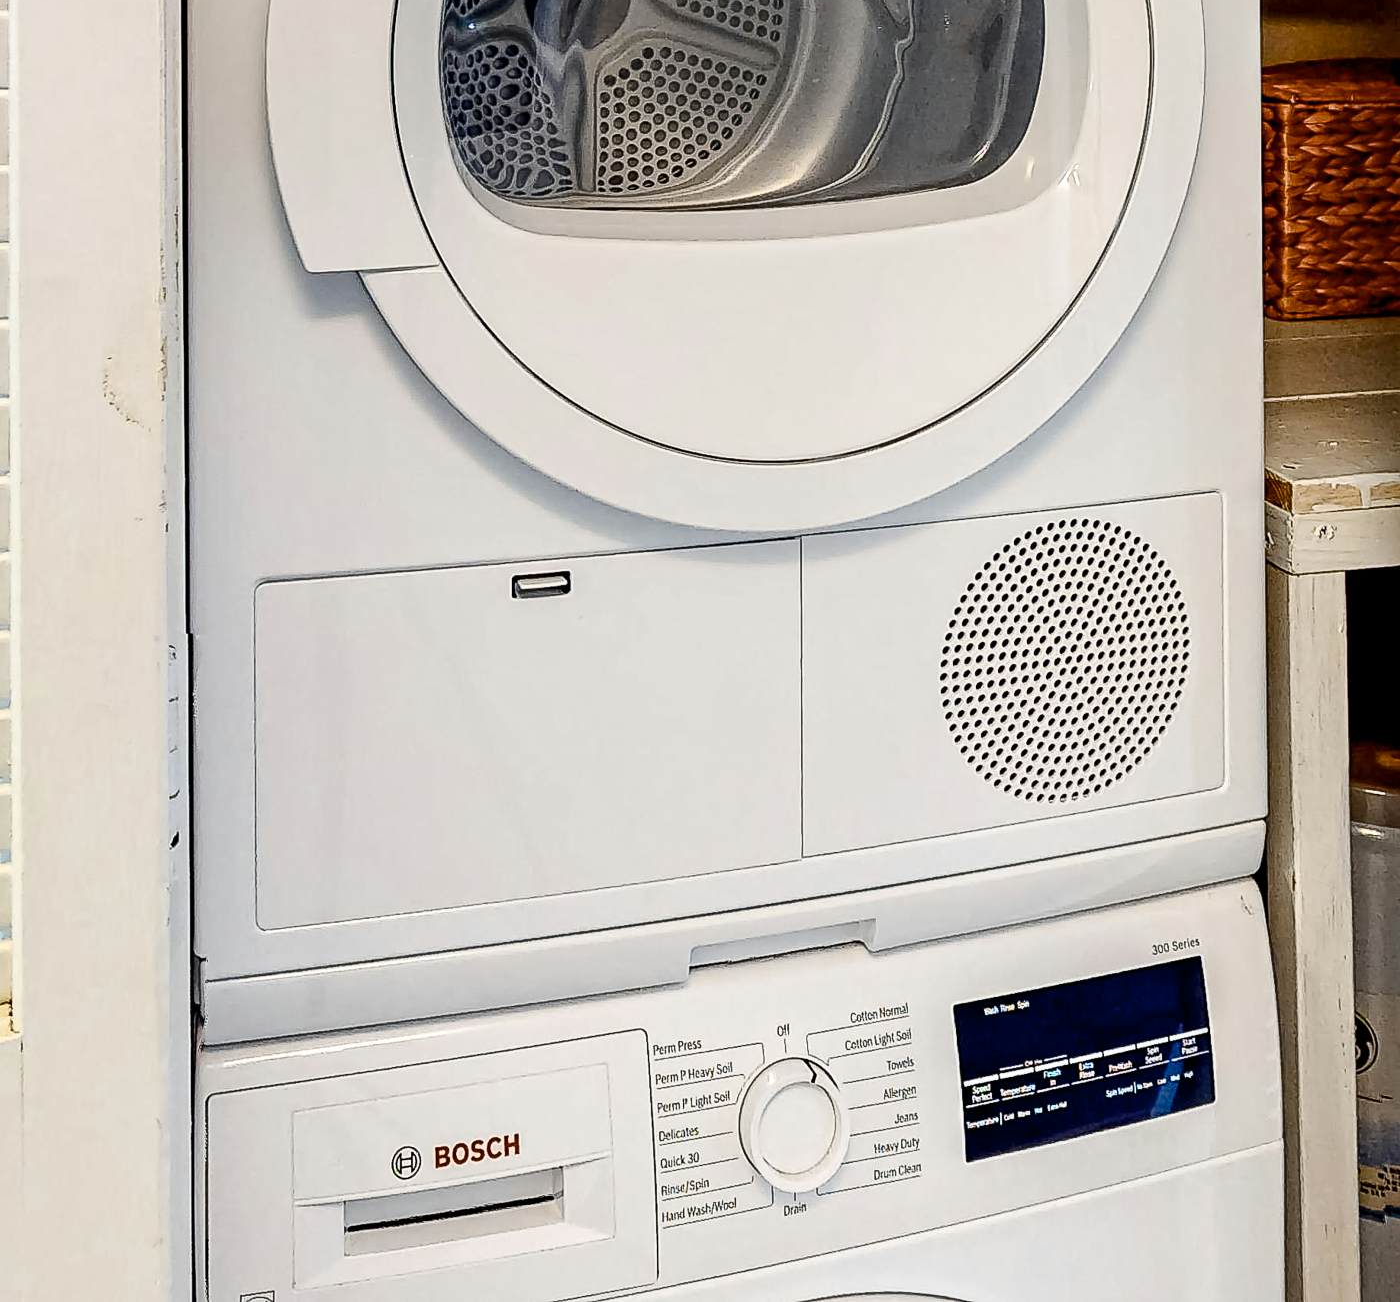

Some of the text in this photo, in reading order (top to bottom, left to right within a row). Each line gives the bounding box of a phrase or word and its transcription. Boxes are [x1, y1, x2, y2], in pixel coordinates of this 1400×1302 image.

[1152, 937, 1200, 956] 300 Series
[850, 1002, 909, 1024] Cotton Normal
[652, 1039, 702, 1057] Perm Press
[845, 1027, 912, 1051] Cotton Light Soil
[655, 1061, 733, 1085] Perm P Heavy Soil
[886, 1056, 915, 1072] Towels
[657, 1090, 731, 1114] Perm P Light Soil
[883, 1085, 917, 1101] Allergen
[894, 1112, 919, 1125] Jeans
[658, 1126, 700, 1142] Delicates
[434, 1133, 520, 1169] BOSCH
[873, 1137, 920, 1154] Heavy Duty
[660, 1151, 700, 1169] Quick 30
[873, 1163, 922, 1181] Drum Clean
[661, 1177, 710, 1197] Rinse/Spin
[661, 1196, 737, 1223] Hand Wash/Wool
[783, 1203, 807, 1217] Drain
